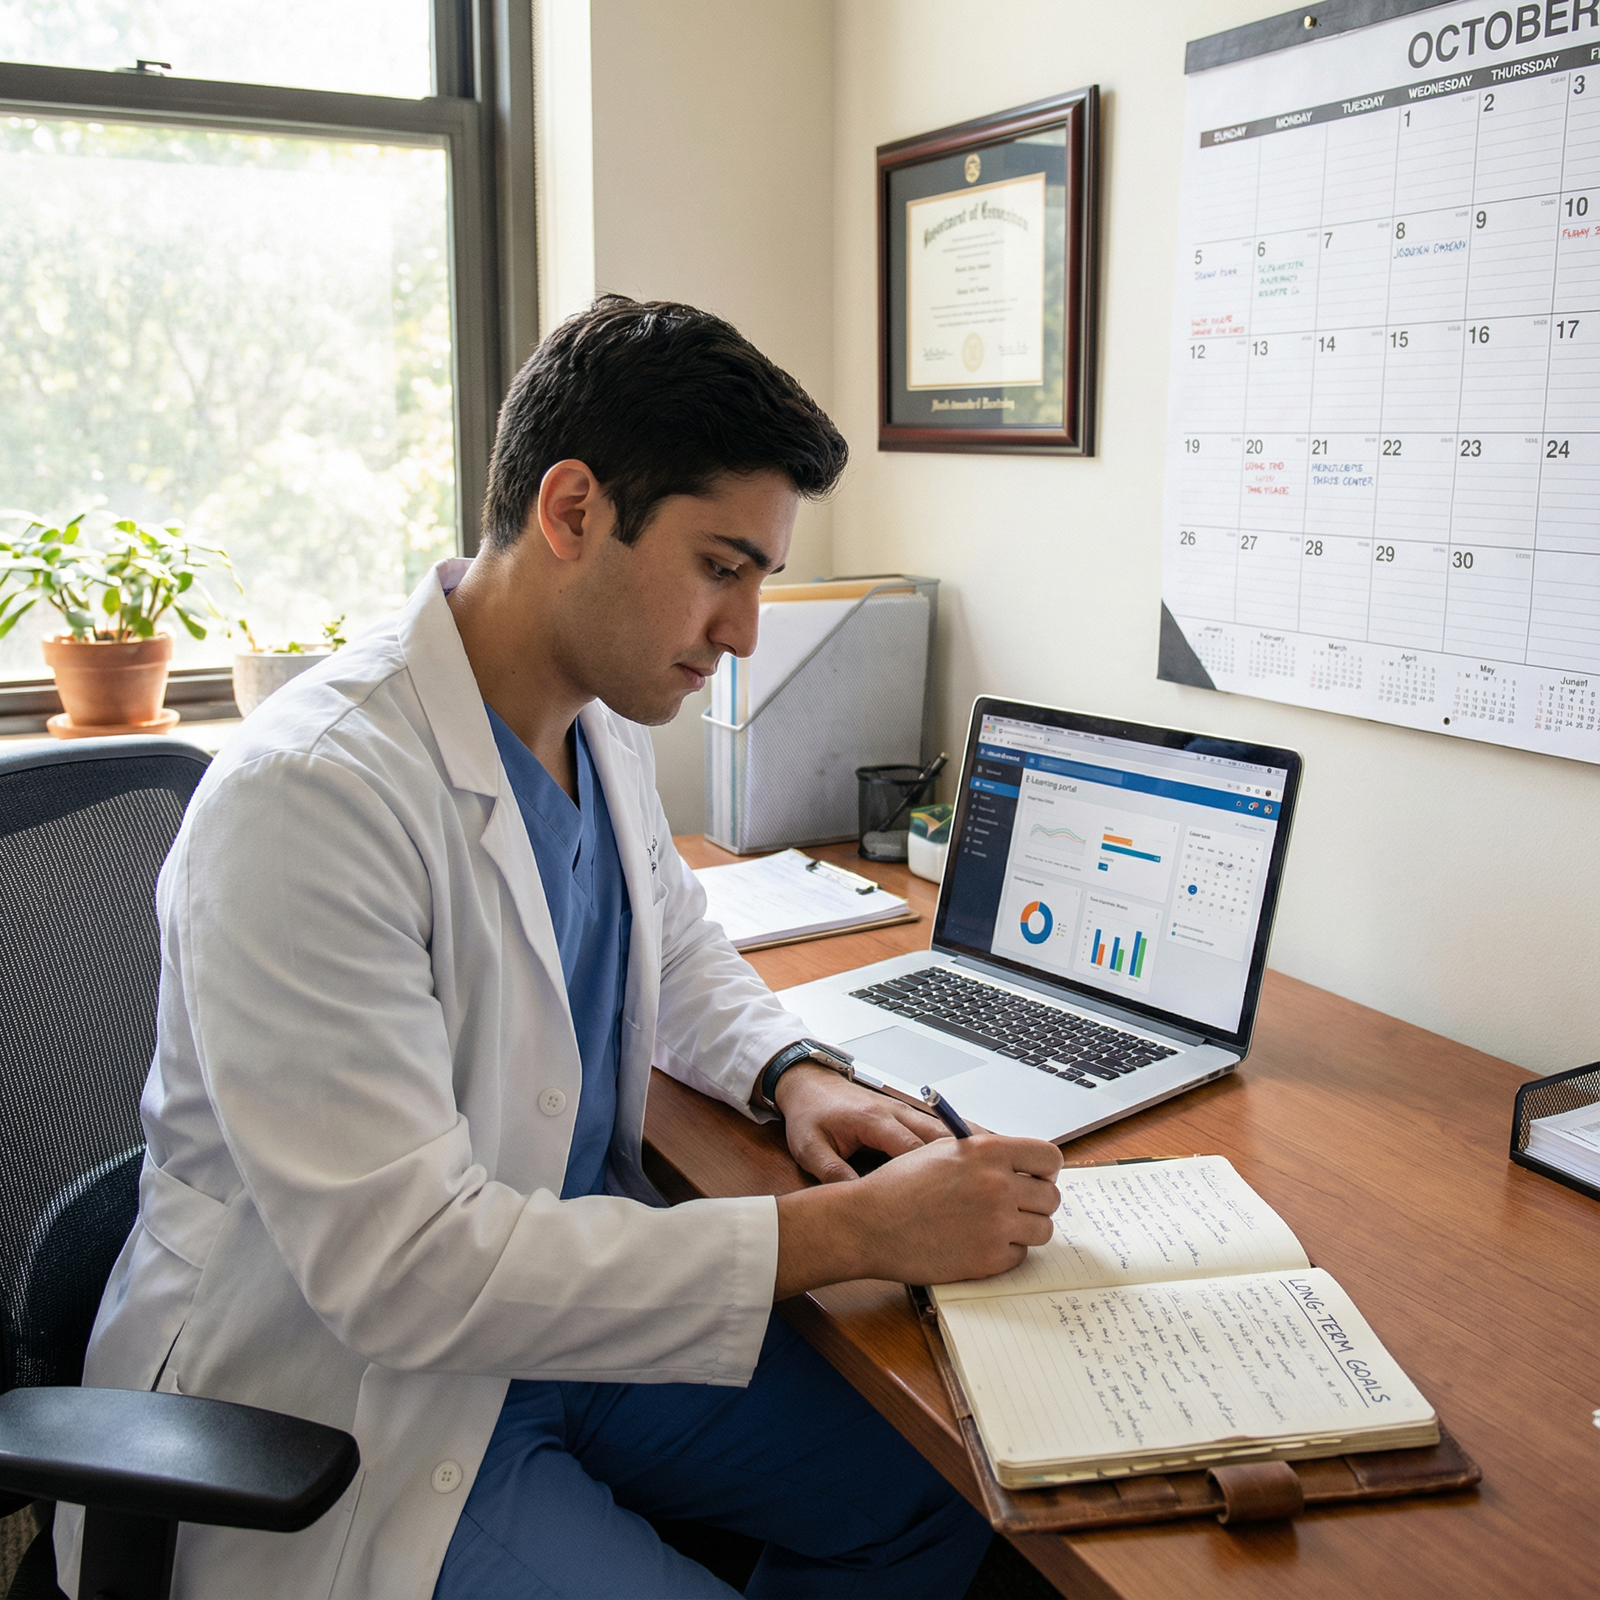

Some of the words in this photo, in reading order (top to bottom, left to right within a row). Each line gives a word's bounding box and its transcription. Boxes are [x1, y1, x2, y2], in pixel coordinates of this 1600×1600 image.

[1408, 0, 1599, 69] OCTOBER
[1275, 111, 1313, 129] MONDAY
[1341, 94, 1385, 114] TUESDAY
[1408, 74, 1473, 99] WEDNESDAY
[1491, 55, 1559, 81] THURSSDAY
[1403, 110, 1411, 128] 1
[1483, 93, 1495, 113] 2
[1573, 74, 1586, 95] 3
[1194, 249, 1203, 266] 5
[1257, 241, 1266, 258] 6
[1323, 231, 1334, 249] 7
[1395, 221, 1406, 240] 8
[1475, 210, 1487, 230] 9
[1564, 196, 1589, 218] 10
[1190, 344, 1206, 360] 12
[1252, 340, 1269, 356] 13
[1318, 335, 1336, 353] 14
[1390, 330, 1409, 349] 15
[1468, 325, 1490, 345] 16
[1556, 319, 1580, 339] 17
[1184, 438, 1201, 454] 19
[1245, 438, 1264, 455] 20
[1311, 439, 1328, 455] 21
[1382, 439, 1402, 457] 22
[1460, 439, 1482, 458] 23
[1545, 439, 1571, 459] 24
[1180, 530, 1196, 546] 26
[1240, 534, 1258, 551] 27
[1304, 539, 1324, 557] 28
[1375, 545, 1395, 563] 29
[1452, 551, 1474, 570] 30
[1480, 664, 1495, 675] May
[1288, 1279, 1354, 1353] LONG-TERM
[1346, 1359, 1391, 1403] GOALS
